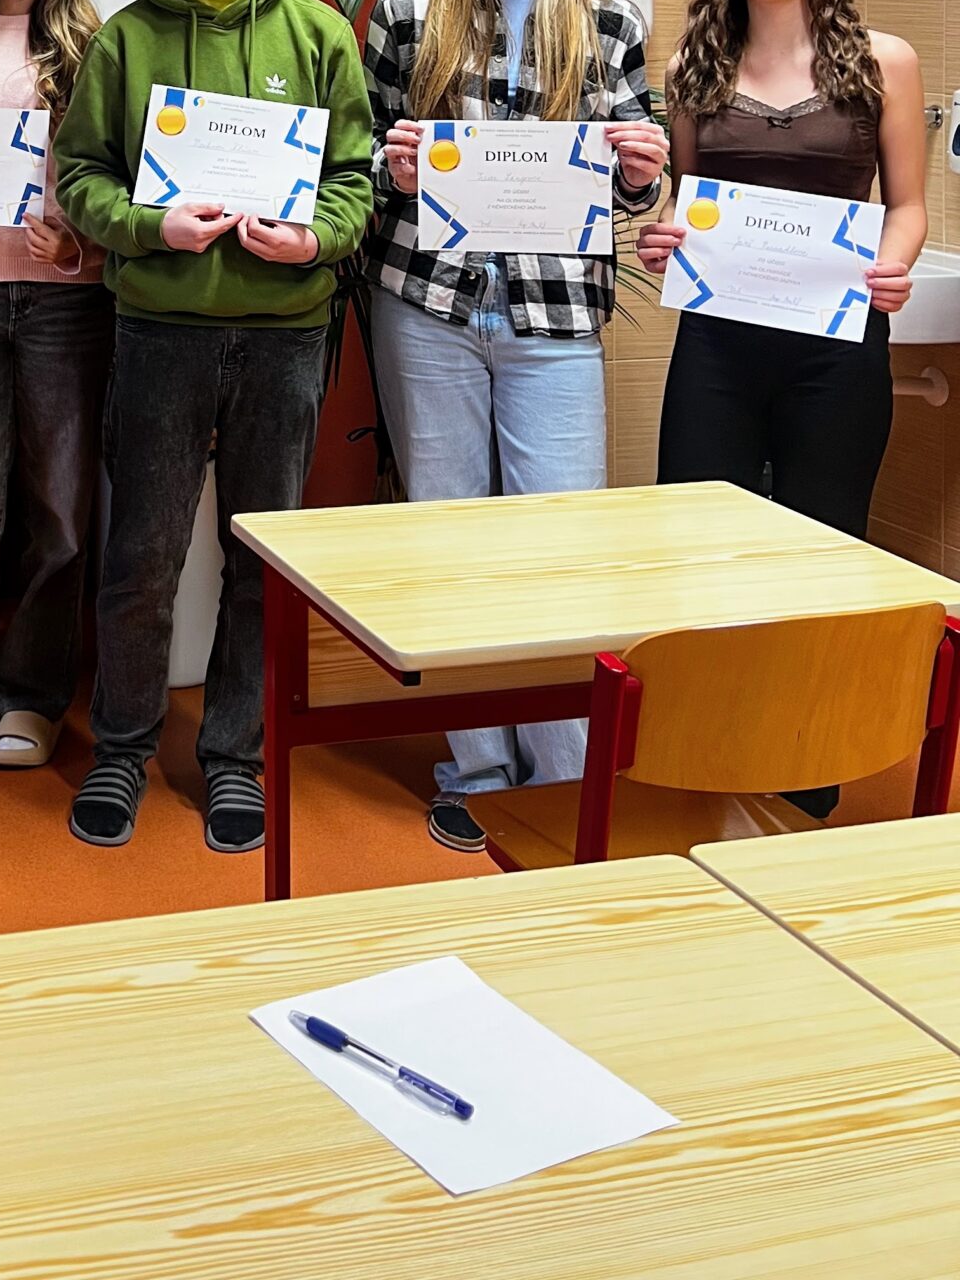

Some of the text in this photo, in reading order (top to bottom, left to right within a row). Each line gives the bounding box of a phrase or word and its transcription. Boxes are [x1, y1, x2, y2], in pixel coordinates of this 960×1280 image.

[208, 121, 266, 139] DIPLOM
[484, 150, 548, 163] DIPLOM
[745, 215, 811, 237] DIPLOM
